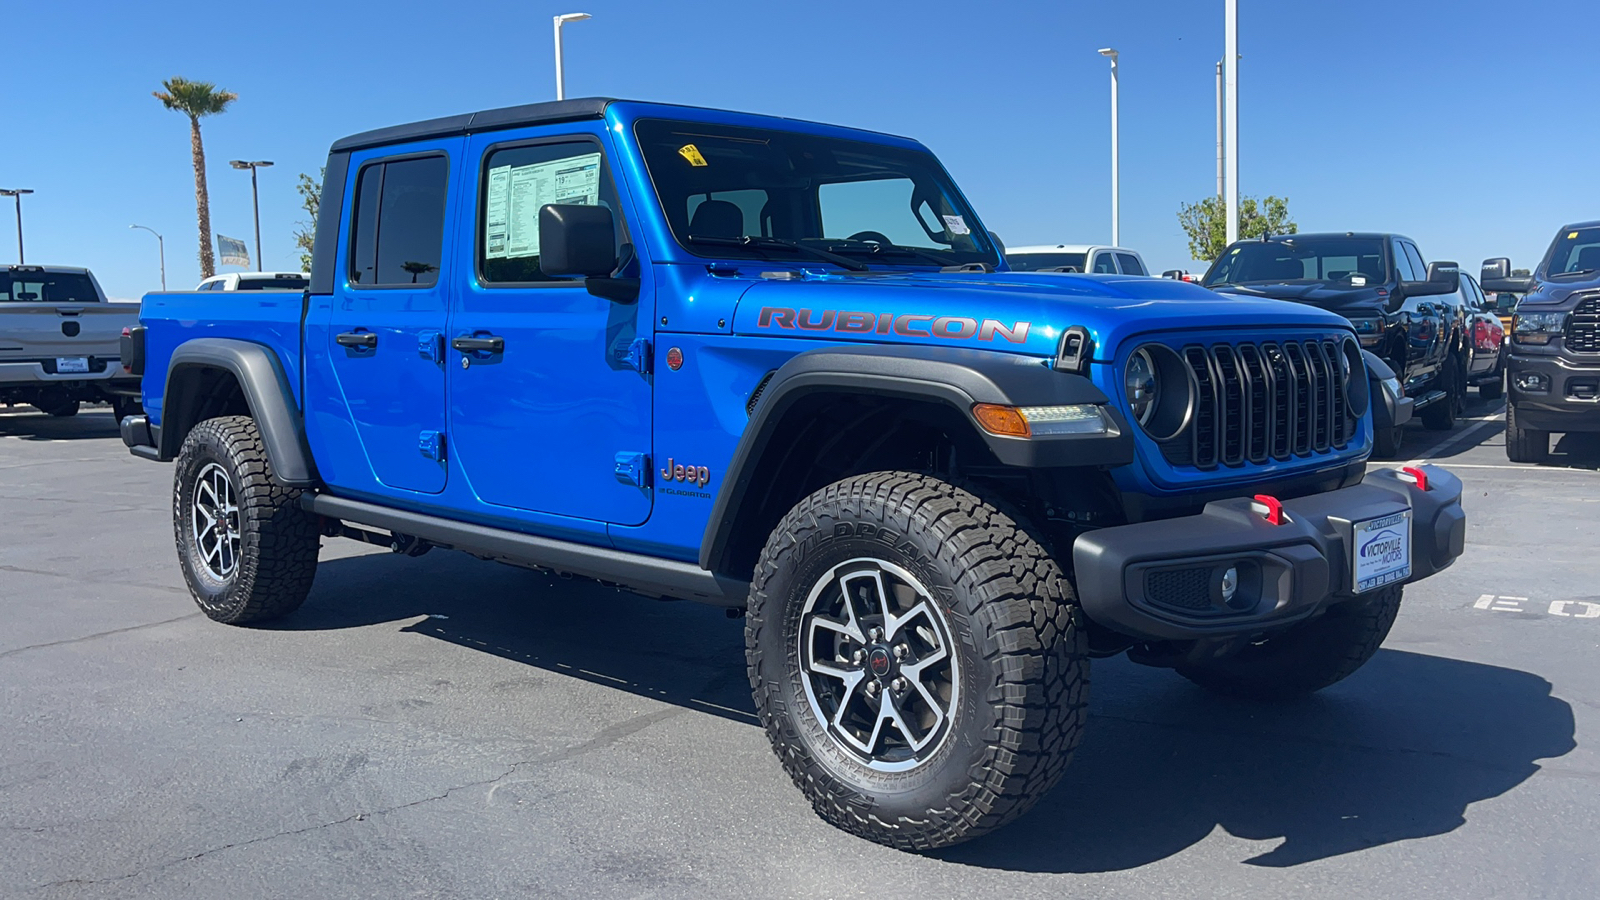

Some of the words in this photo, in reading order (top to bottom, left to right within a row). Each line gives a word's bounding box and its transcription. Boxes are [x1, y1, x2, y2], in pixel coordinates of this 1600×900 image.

[757, 306, 1031, 344] RUBICON
[660, 457, 710, 488] Jeep
[666, 488, 711, 499] GLADIATOR
[786, 520, 943, 583] WILDPEAK
[1366, 537, 1401, 557] VICTORVILLE
[1382, 549, 1403, 565] MOTORS
